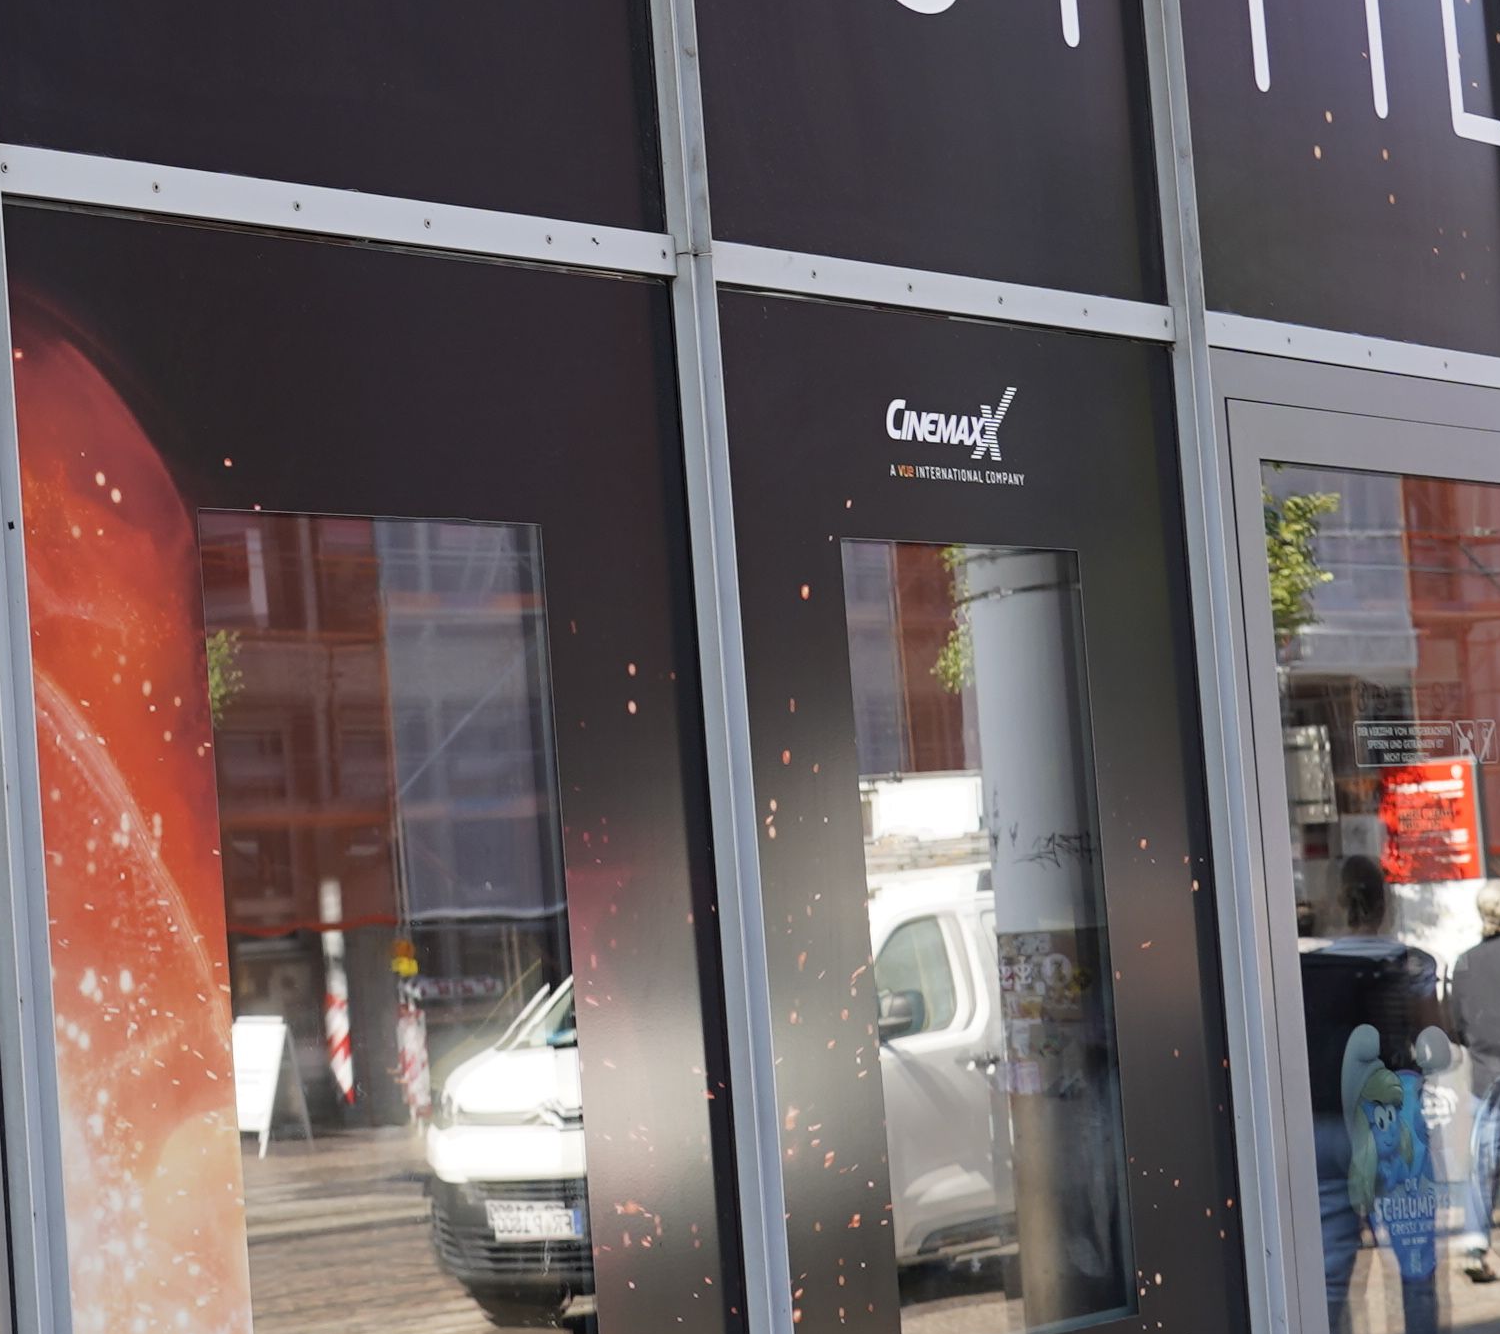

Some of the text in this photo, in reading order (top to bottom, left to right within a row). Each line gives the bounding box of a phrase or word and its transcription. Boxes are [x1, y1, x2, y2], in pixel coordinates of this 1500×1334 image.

[886, 386, 1017, 462] CINEMAXX
[890, 464, 1025, 487] A vue INTERNATIONAL COMPANY
